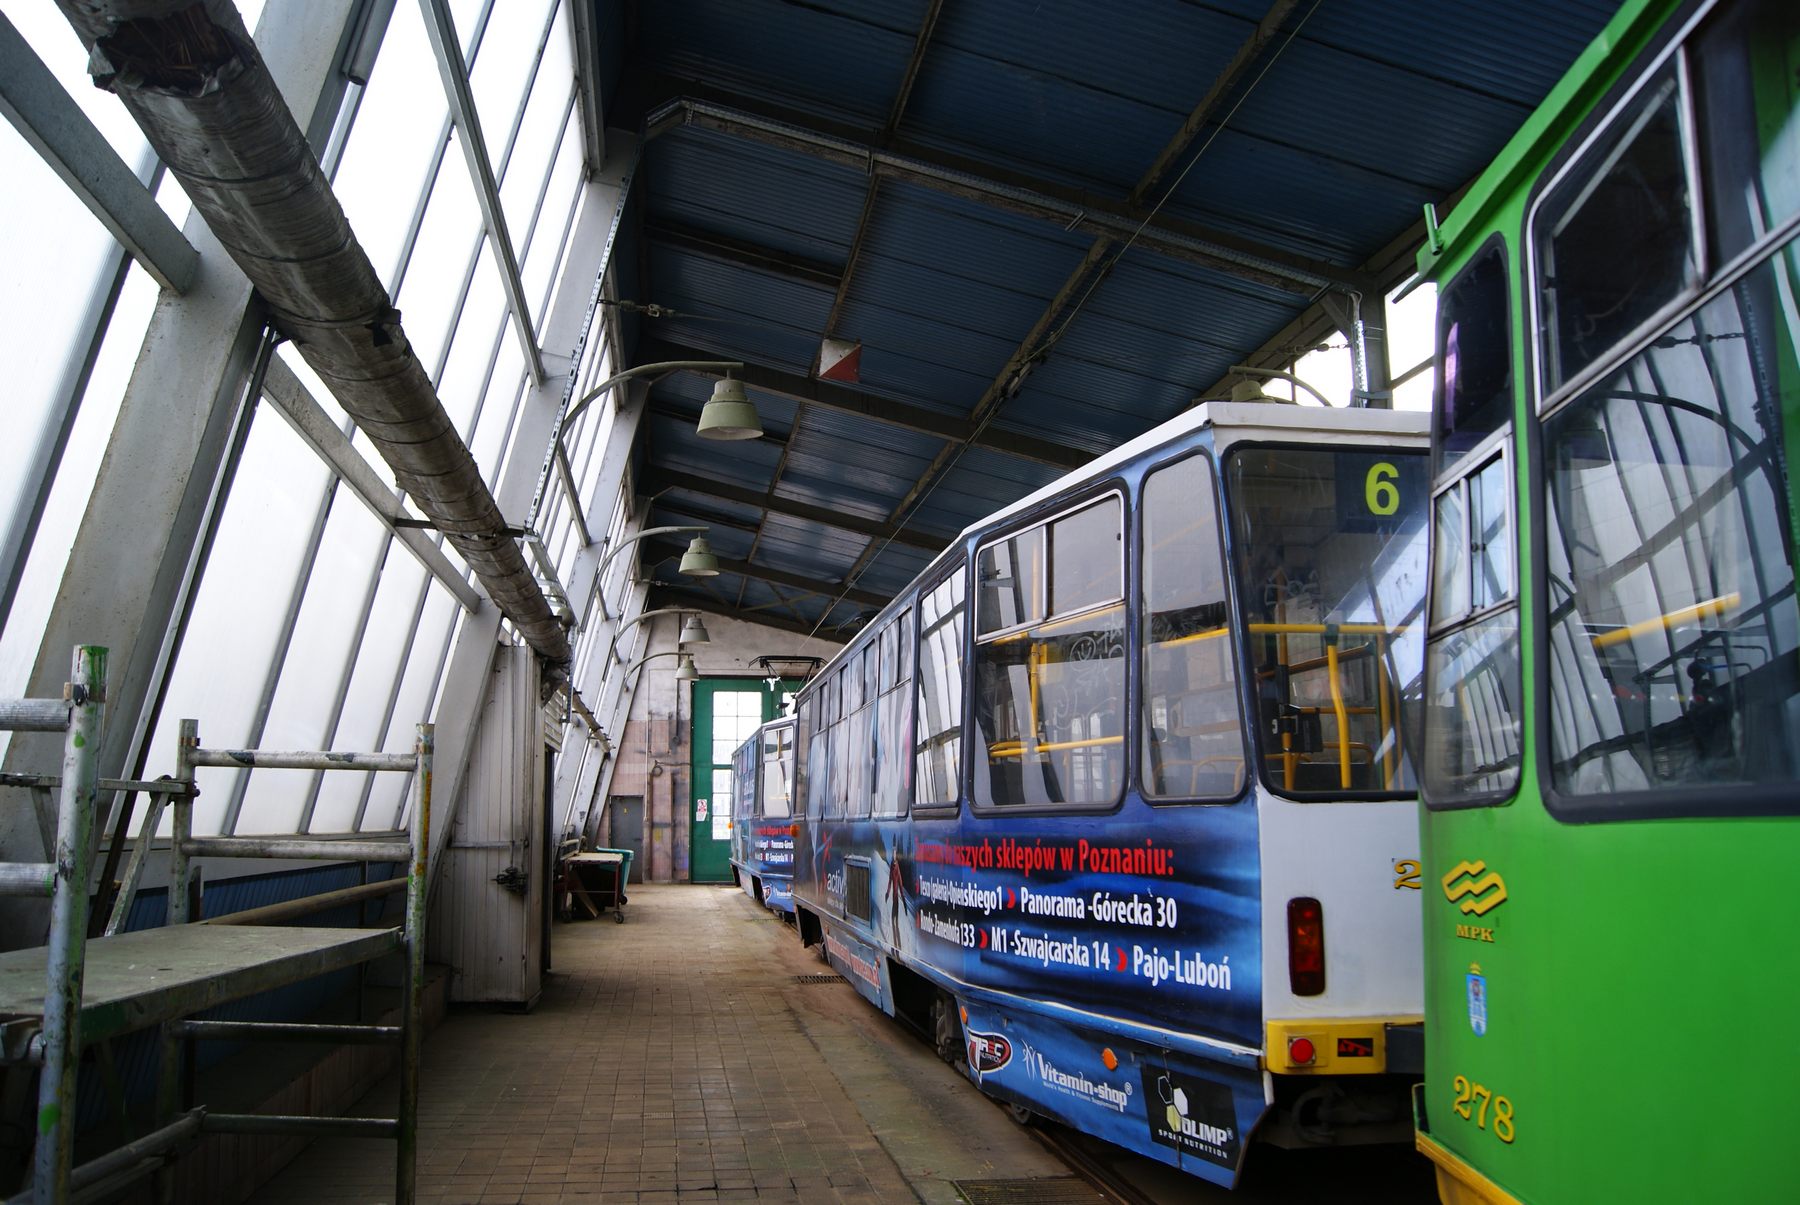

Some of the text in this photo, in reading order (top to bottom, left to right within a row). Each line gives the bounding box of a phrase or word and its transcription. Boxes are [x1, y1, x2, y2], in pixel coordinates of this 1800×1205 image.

[1365, 462, 1400, 516] 6
[996, 838, 1056, 878] sklepów
[1060, 846, 1074, 871] w
[1078, 838, 1175, 877] Poznaniu:
[1020, 886, 1085, 919] Panorama
[1156, 897, 1178, 929] 30
[960, 922, 976, 948] 133
[1456, 923, 1495, 944] MPK
[991, 926, 1009, 953] M1
[1093, 942, 1111, 971] 14
[1132, 945, 1232, 991] Pajo-Luboń
[1453, 1074, 1515, 1144] 278
[1184, 1138, 1228, 1159] NUTRITION
